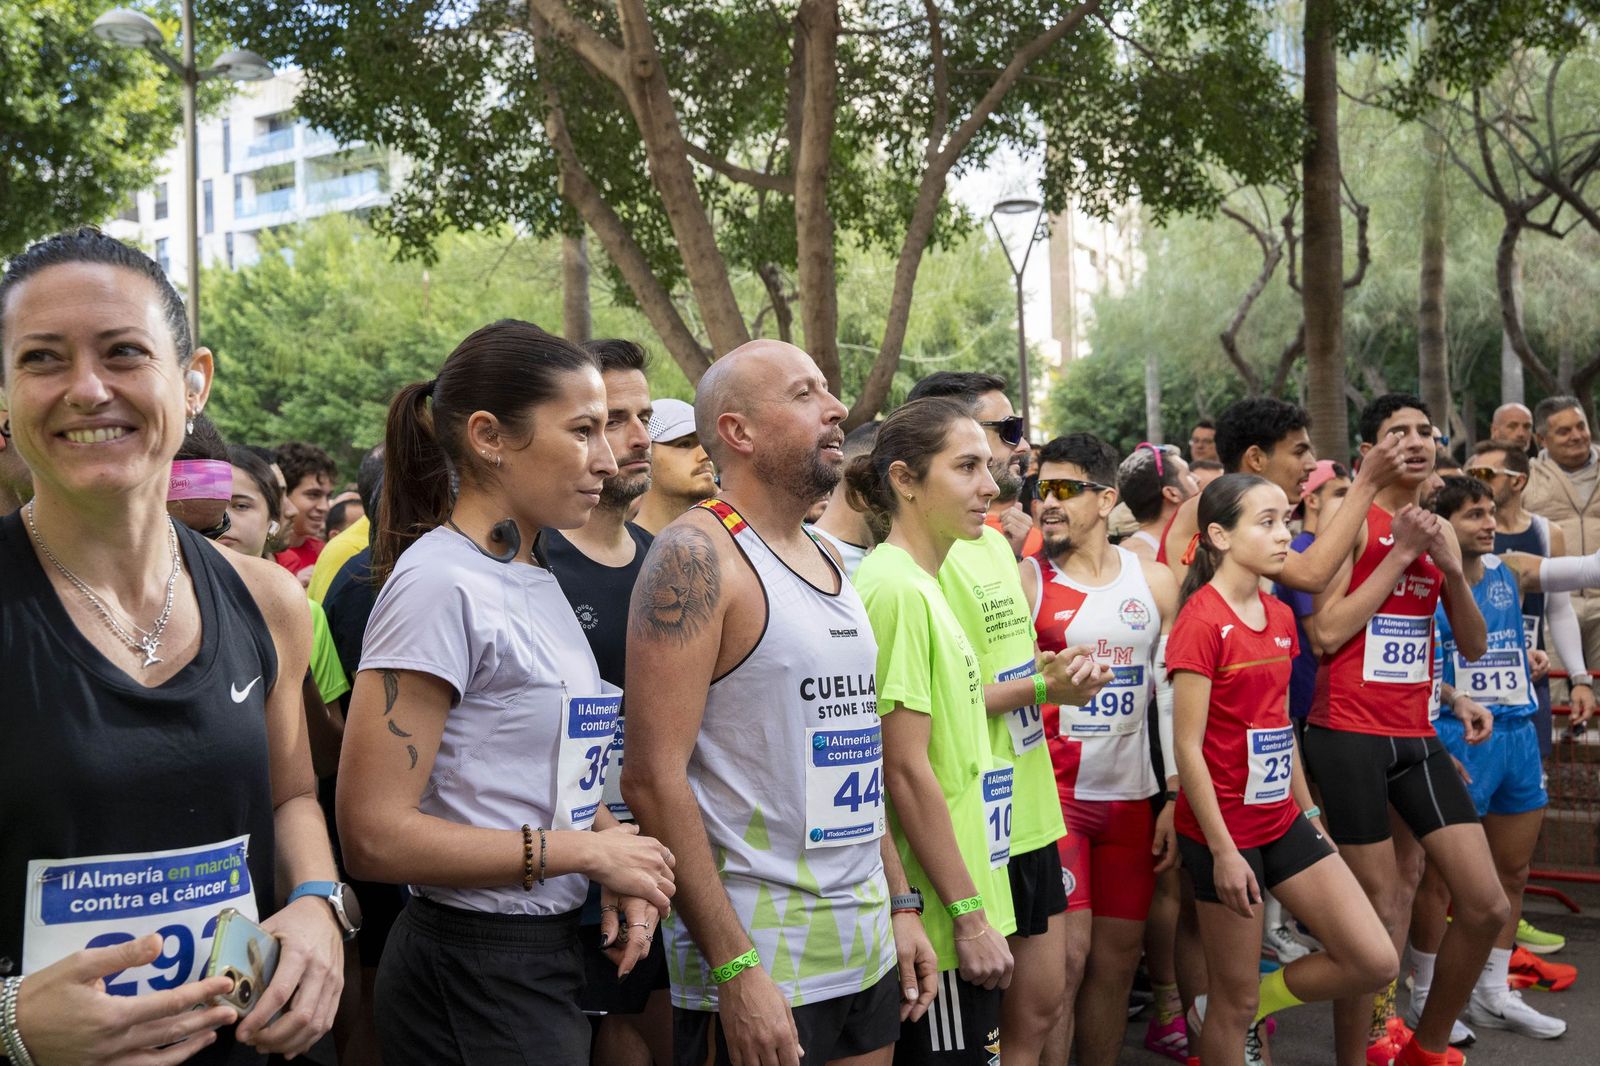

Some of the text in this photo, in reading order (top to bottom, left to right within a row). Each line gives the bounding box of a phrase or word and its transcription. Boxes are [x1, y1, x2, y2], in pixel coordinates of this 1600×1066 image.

[1383, 641, 1427, 664] 884
[1471, 671, 1517, 691] 813
[578, 704, 584, 715] II
[818, 702, 858, 719] STONE
[1079, 691, 1134, 716] 498
[581, 719, 610, 731] contra
[831, 734, 870, 746] Almería
[828, 751, 862, 760] contra
[865, 746, 872, 757] el
[1263, 754, 1291, 783] 23
[991, 787, 1010, 796] contra
[62, 853, 241, 890] II Almería en marcha
[70, 879, 226, 913] contra el cáncer
